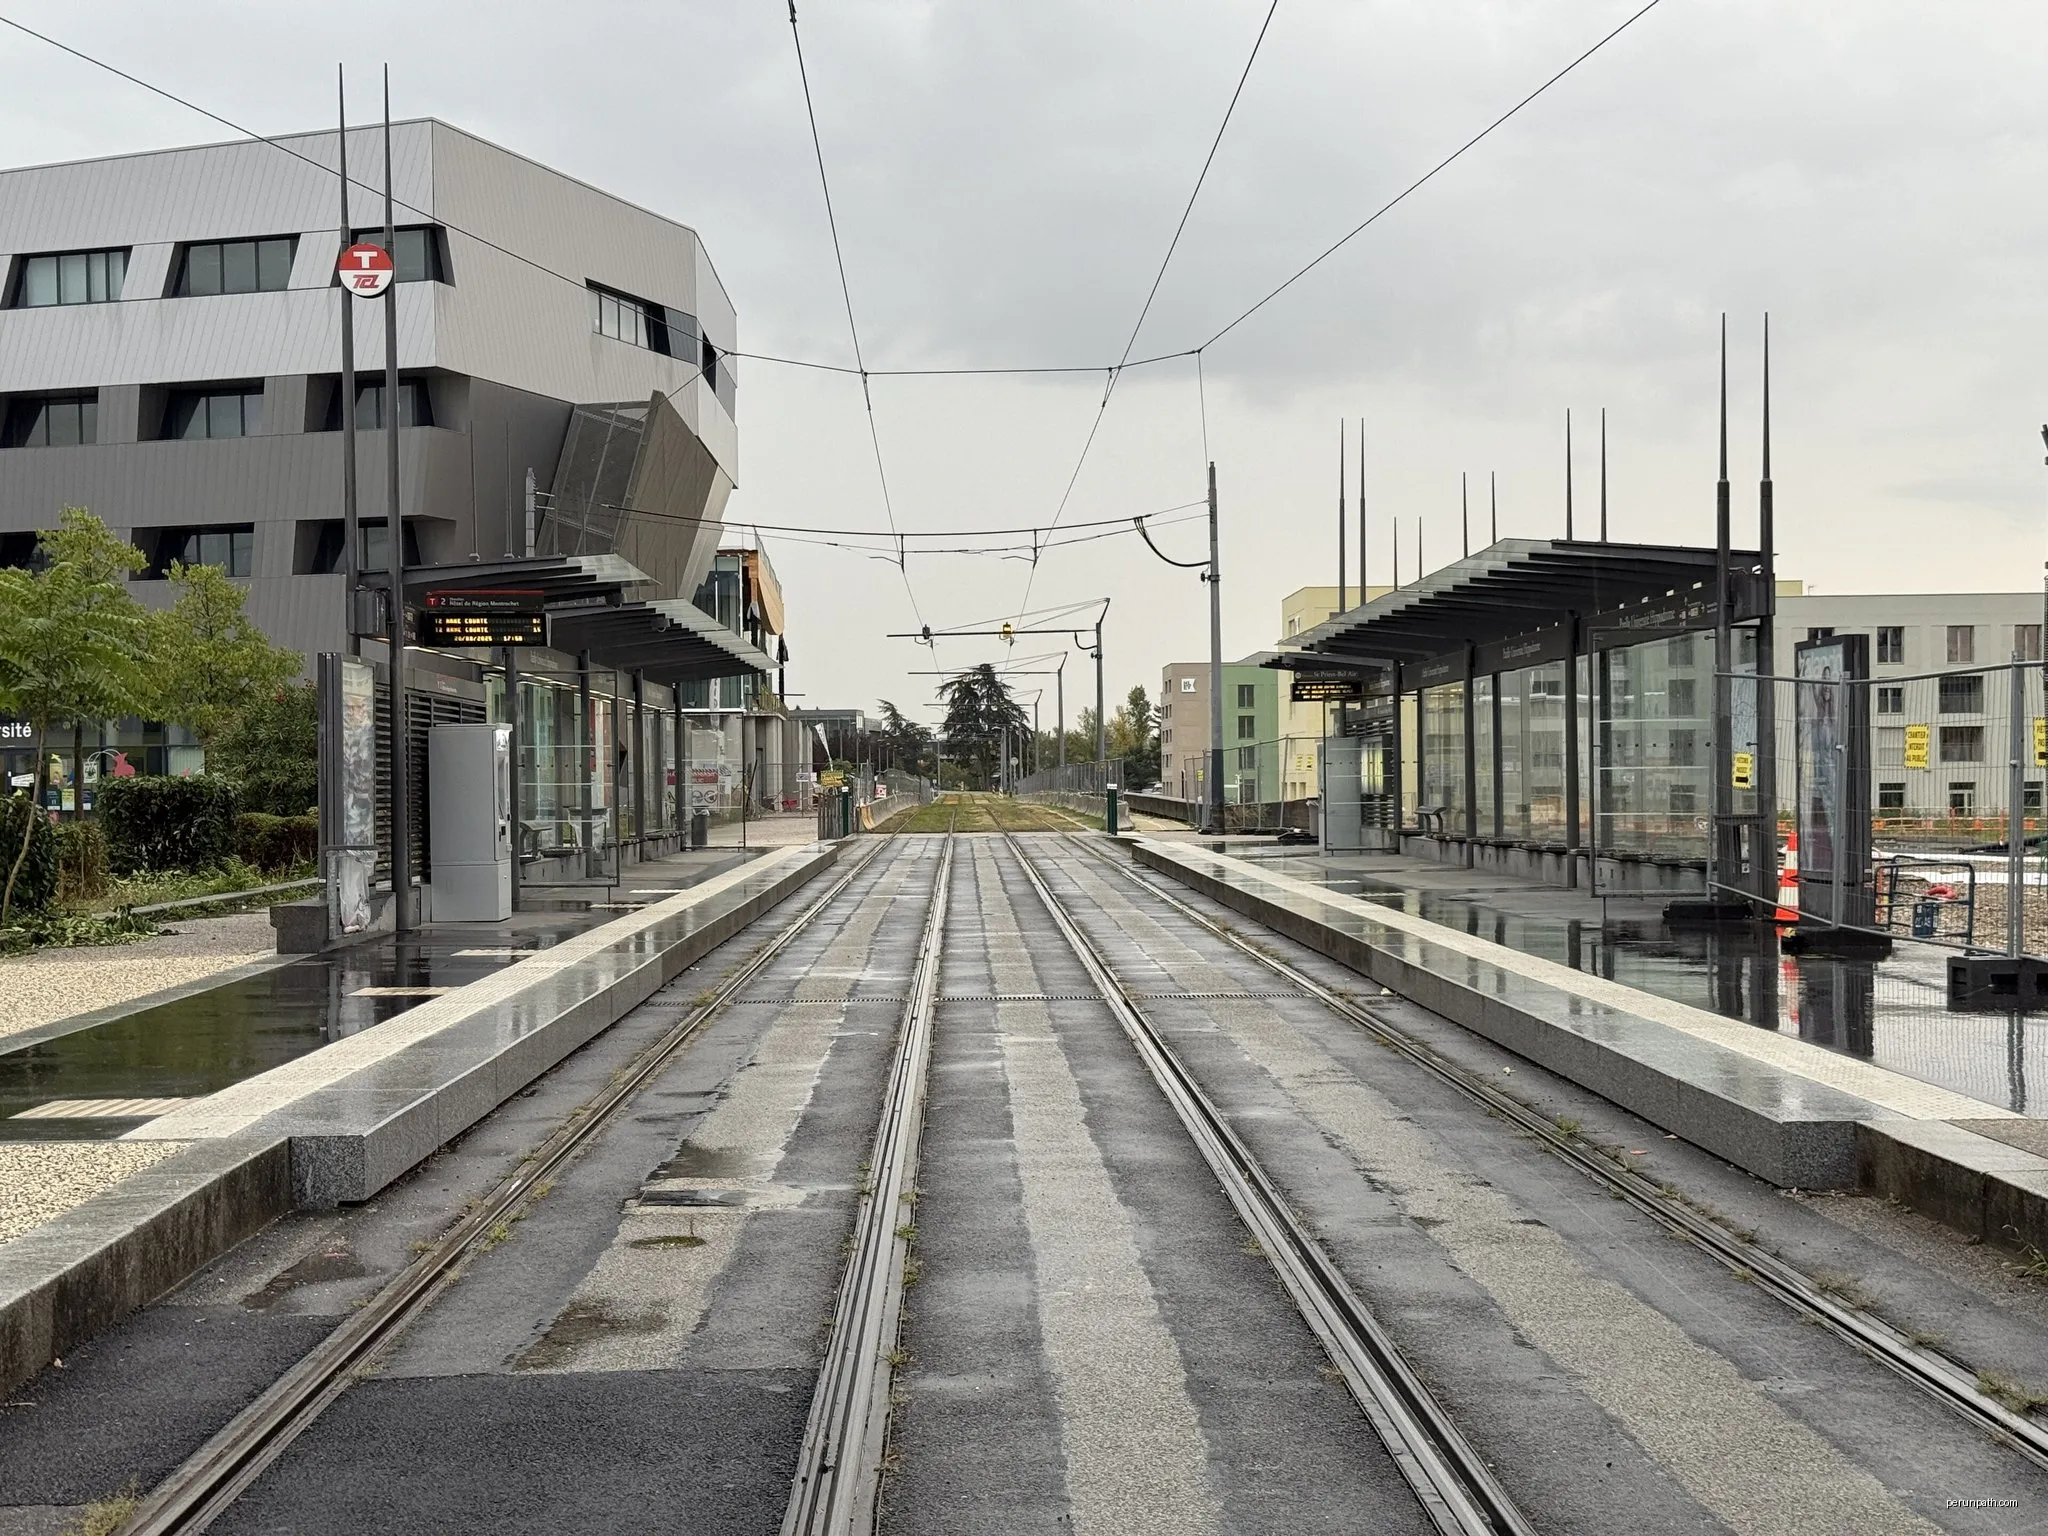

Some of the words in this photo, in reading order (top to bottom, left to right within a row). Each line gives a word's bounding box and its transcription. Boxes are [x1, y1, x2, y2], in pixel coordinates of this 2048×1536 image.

[353, 251, 378, 269] T
[353, 274, 379, 289] TCL
[440, 598, 446, 606] 2
[0, 722, 32, 738] sité
